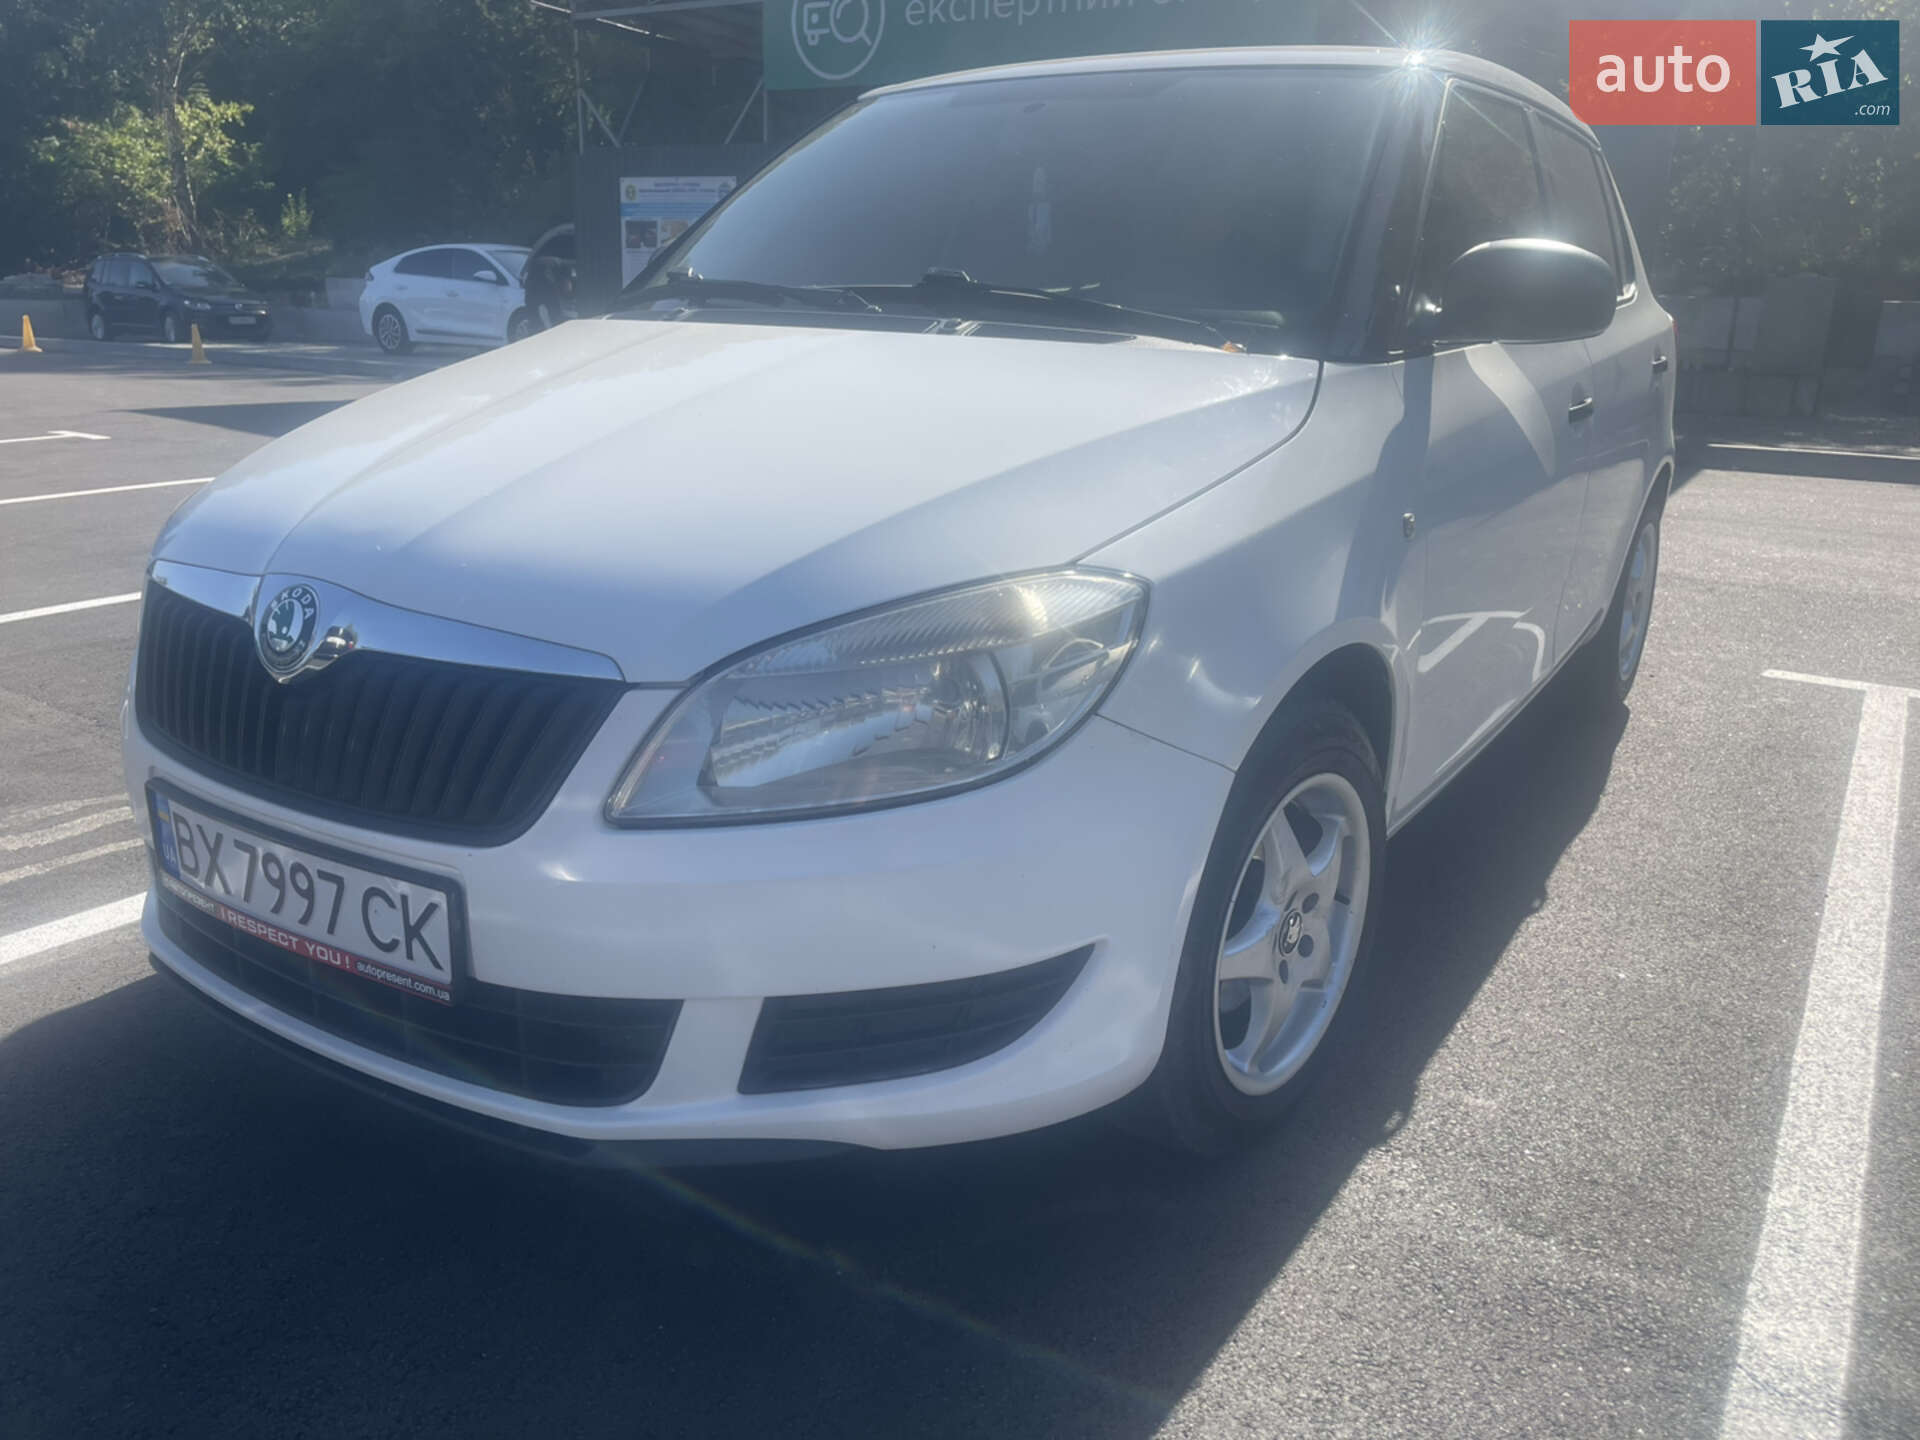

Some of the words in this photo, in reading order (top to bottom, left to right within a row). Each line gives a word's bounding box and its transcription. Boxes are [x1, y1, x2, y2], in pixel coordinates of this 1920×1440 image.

[172, 811, 232, 895] BX
[233, 839, 344, 935] 7997
[361, 886, 444, 970] CK
[227, 911, 300, 948] RESPECT
[304, 941, 341, 966] YOU
[356, 960, 451, 1001] autopresent.com.ua
